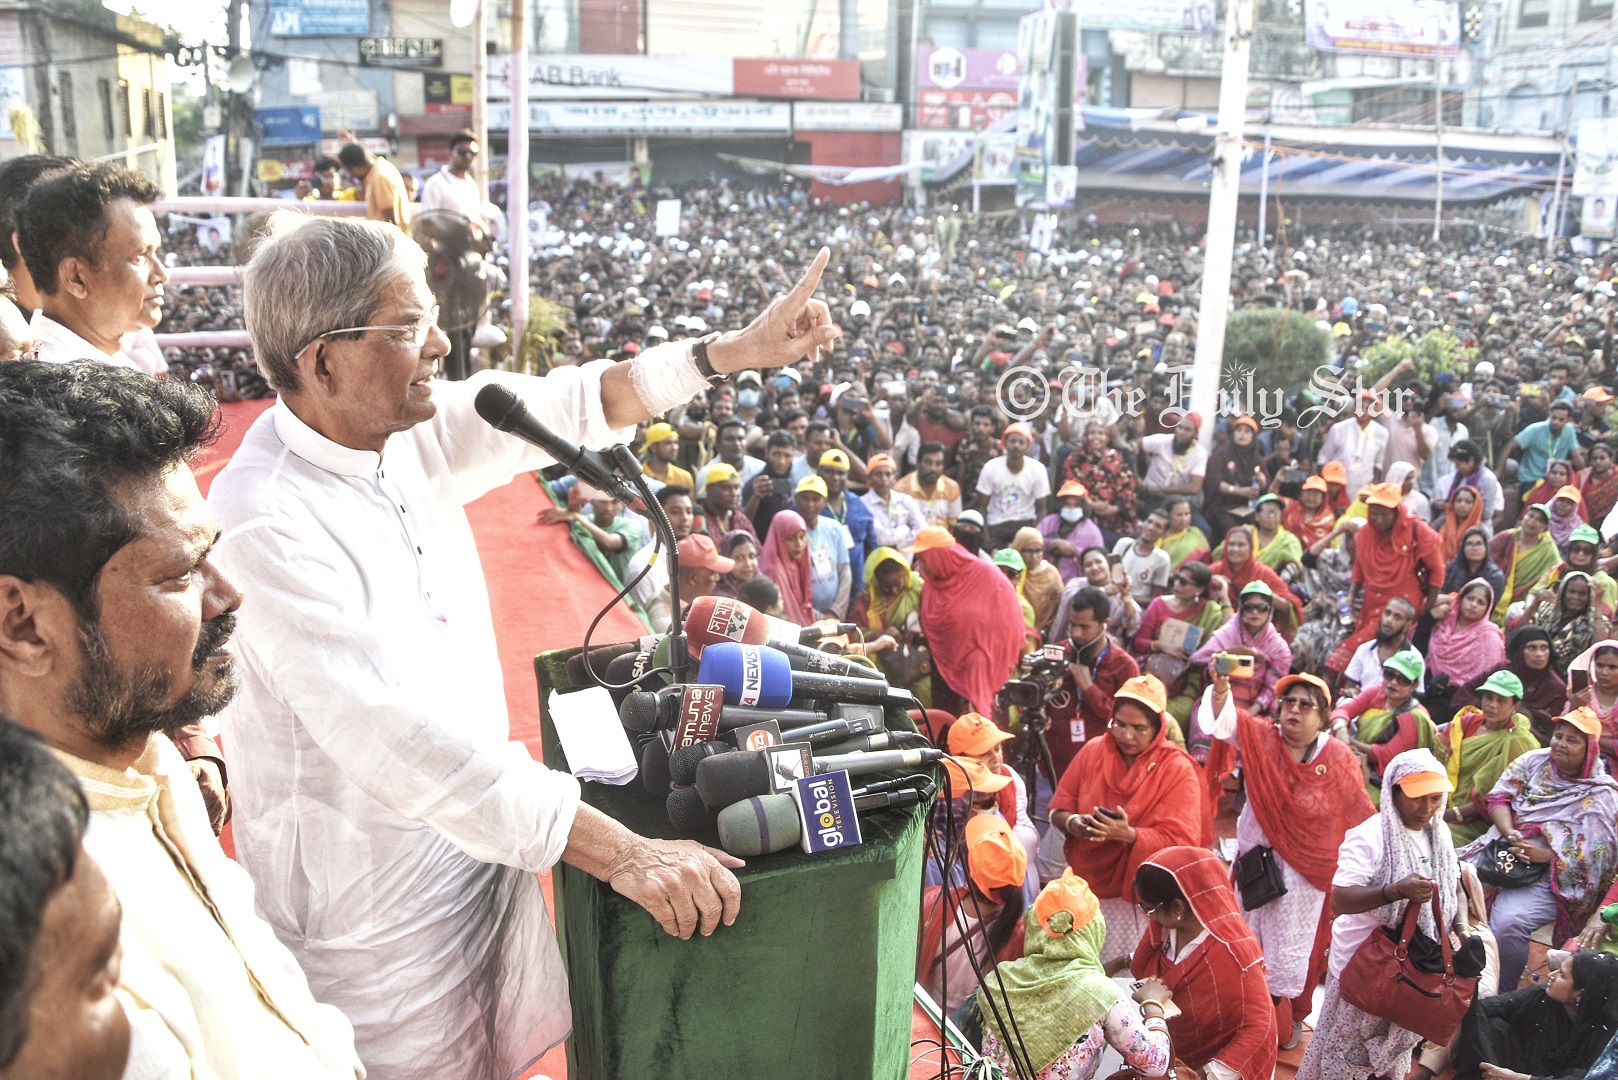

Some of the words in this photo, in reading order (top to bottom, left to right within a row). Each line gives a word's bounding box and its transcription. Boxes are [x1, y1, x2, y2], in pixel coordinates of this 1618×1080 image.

[531, 66, 562, 84] AB
[569, 66, 623, 87] Bank
[746, 651, 758, 691] NEWS
[681, 689, 702, 747] amuna
[699, 690, 715, 732] news
[809, 781, 844, 847] global
[827, 779, 842, 829] TELEVISION
